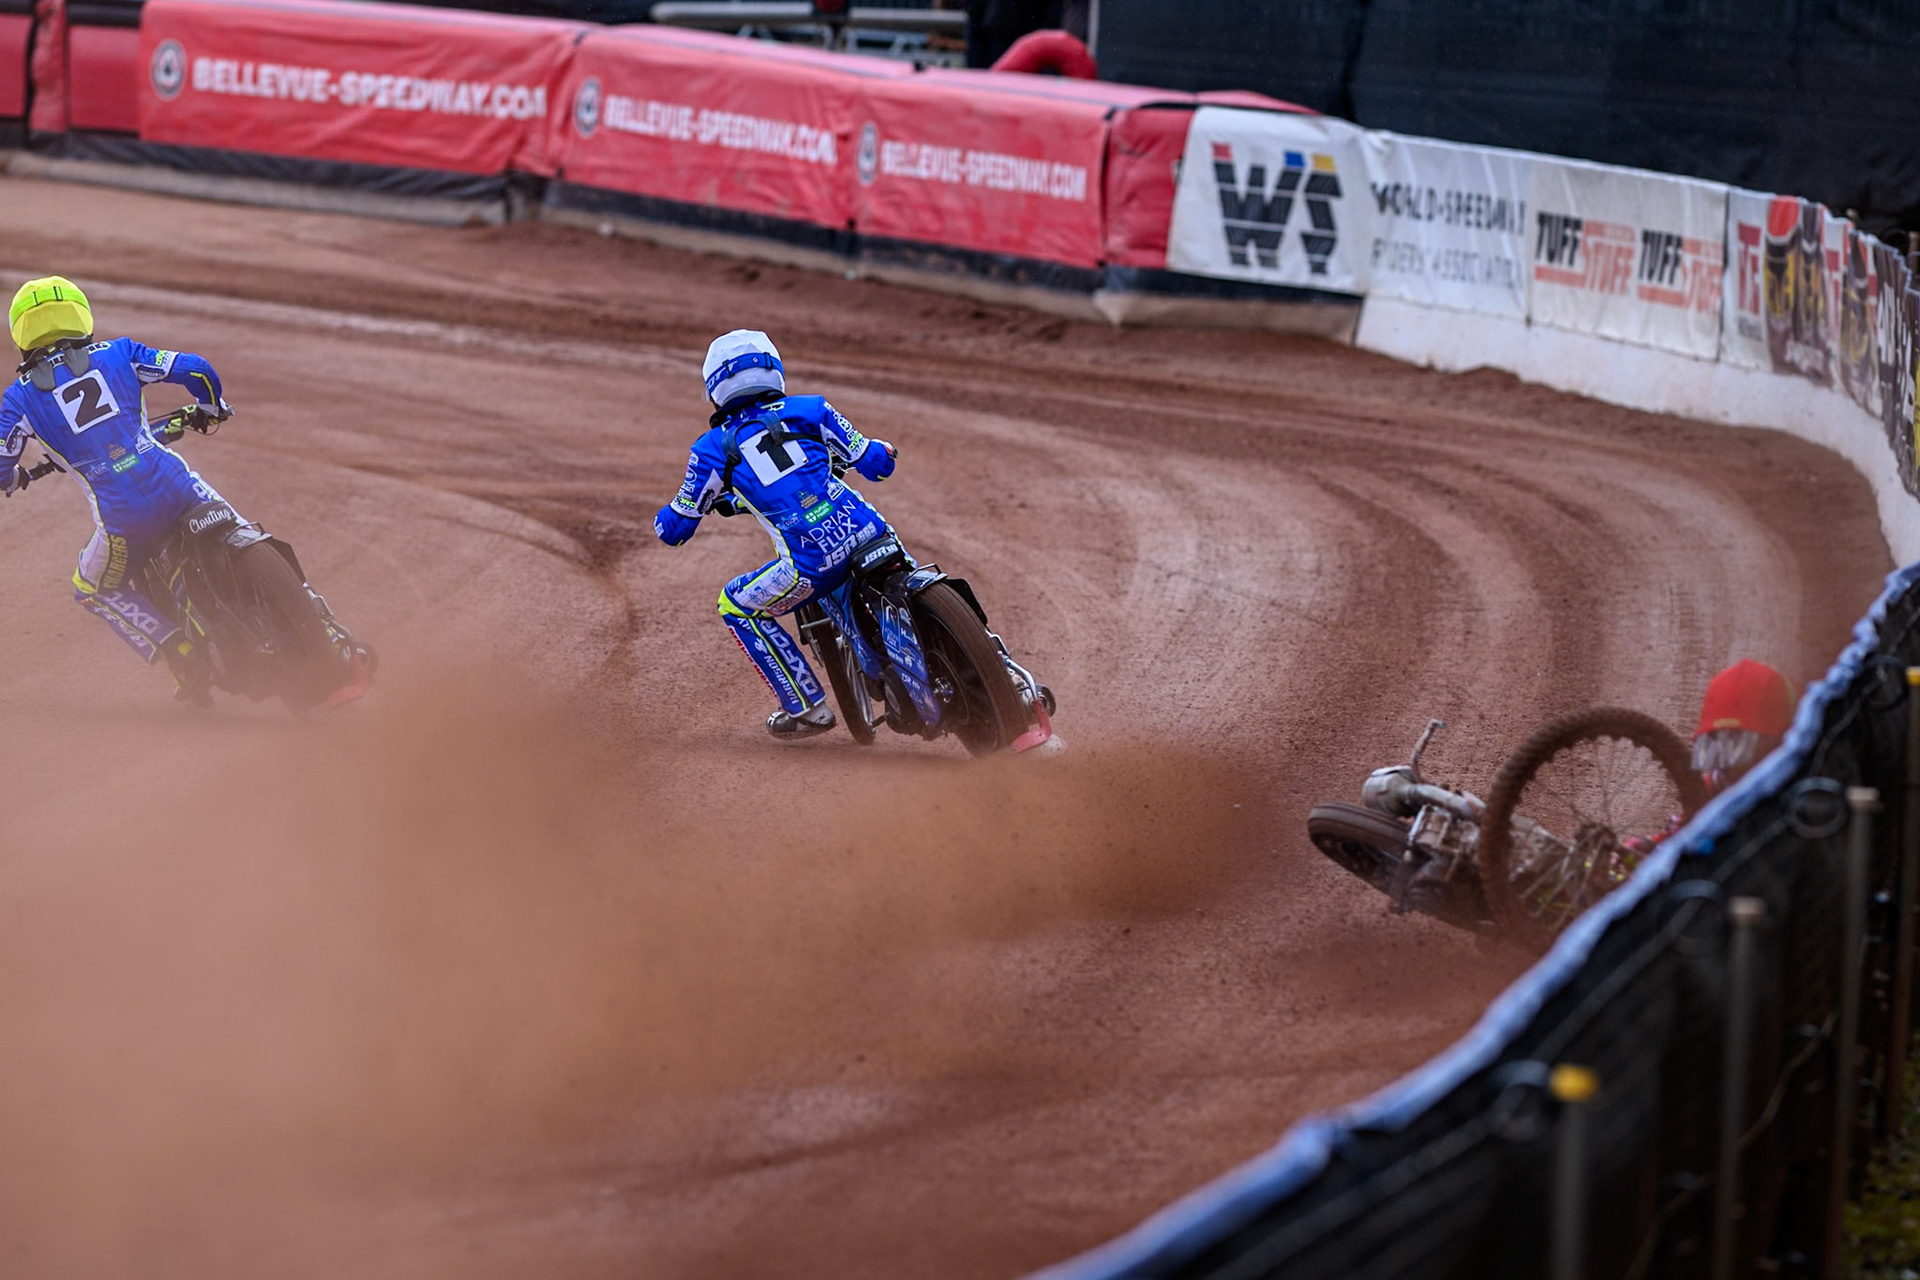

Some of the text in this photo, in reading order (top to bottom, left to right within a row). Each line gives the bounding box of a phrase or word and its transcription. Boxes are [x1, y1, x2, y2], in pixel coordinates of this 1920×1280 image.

[1535, 210, 1583, 268] TUFF
[1638, 228, 1684, 286] TUFF
[61, 376, 114, 429] 2
[755, 429, 795, 473] 1
[188, 507, 232, 534] Clouting
[800, 499, 857, 549] ADRIAN
[817, 516, 858, 554] FLUX
[861, 546, 886, 568] JSR
[760, 619, 819, 696] OXFOR
[763, 655, 800, 705] HARRISON
